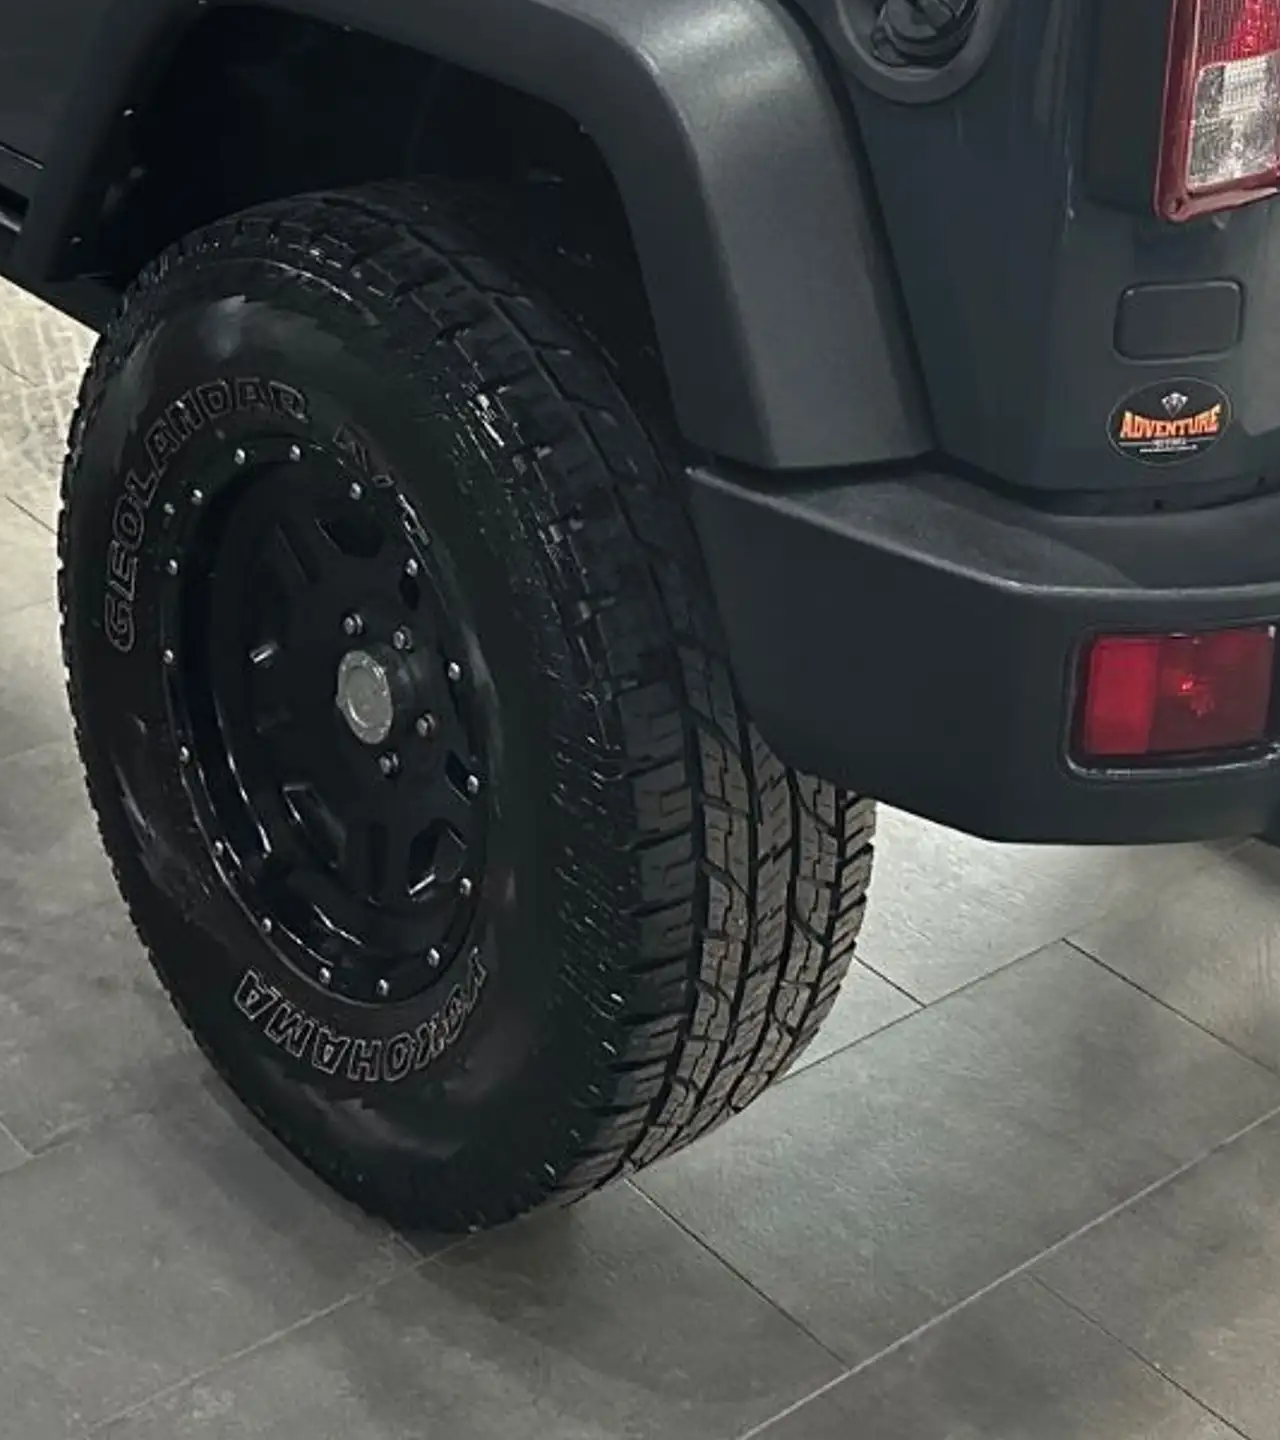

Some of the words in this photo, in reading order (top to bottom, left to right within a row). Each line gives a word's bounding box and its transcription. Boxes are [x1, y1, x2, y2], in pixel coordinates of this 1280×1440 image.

[1119, 403, 1221, 439] ADVENTURE
[104, 377, 308, 652] GEOLANDAR
[234, 947, 487, 1081] YOKOHAMA
